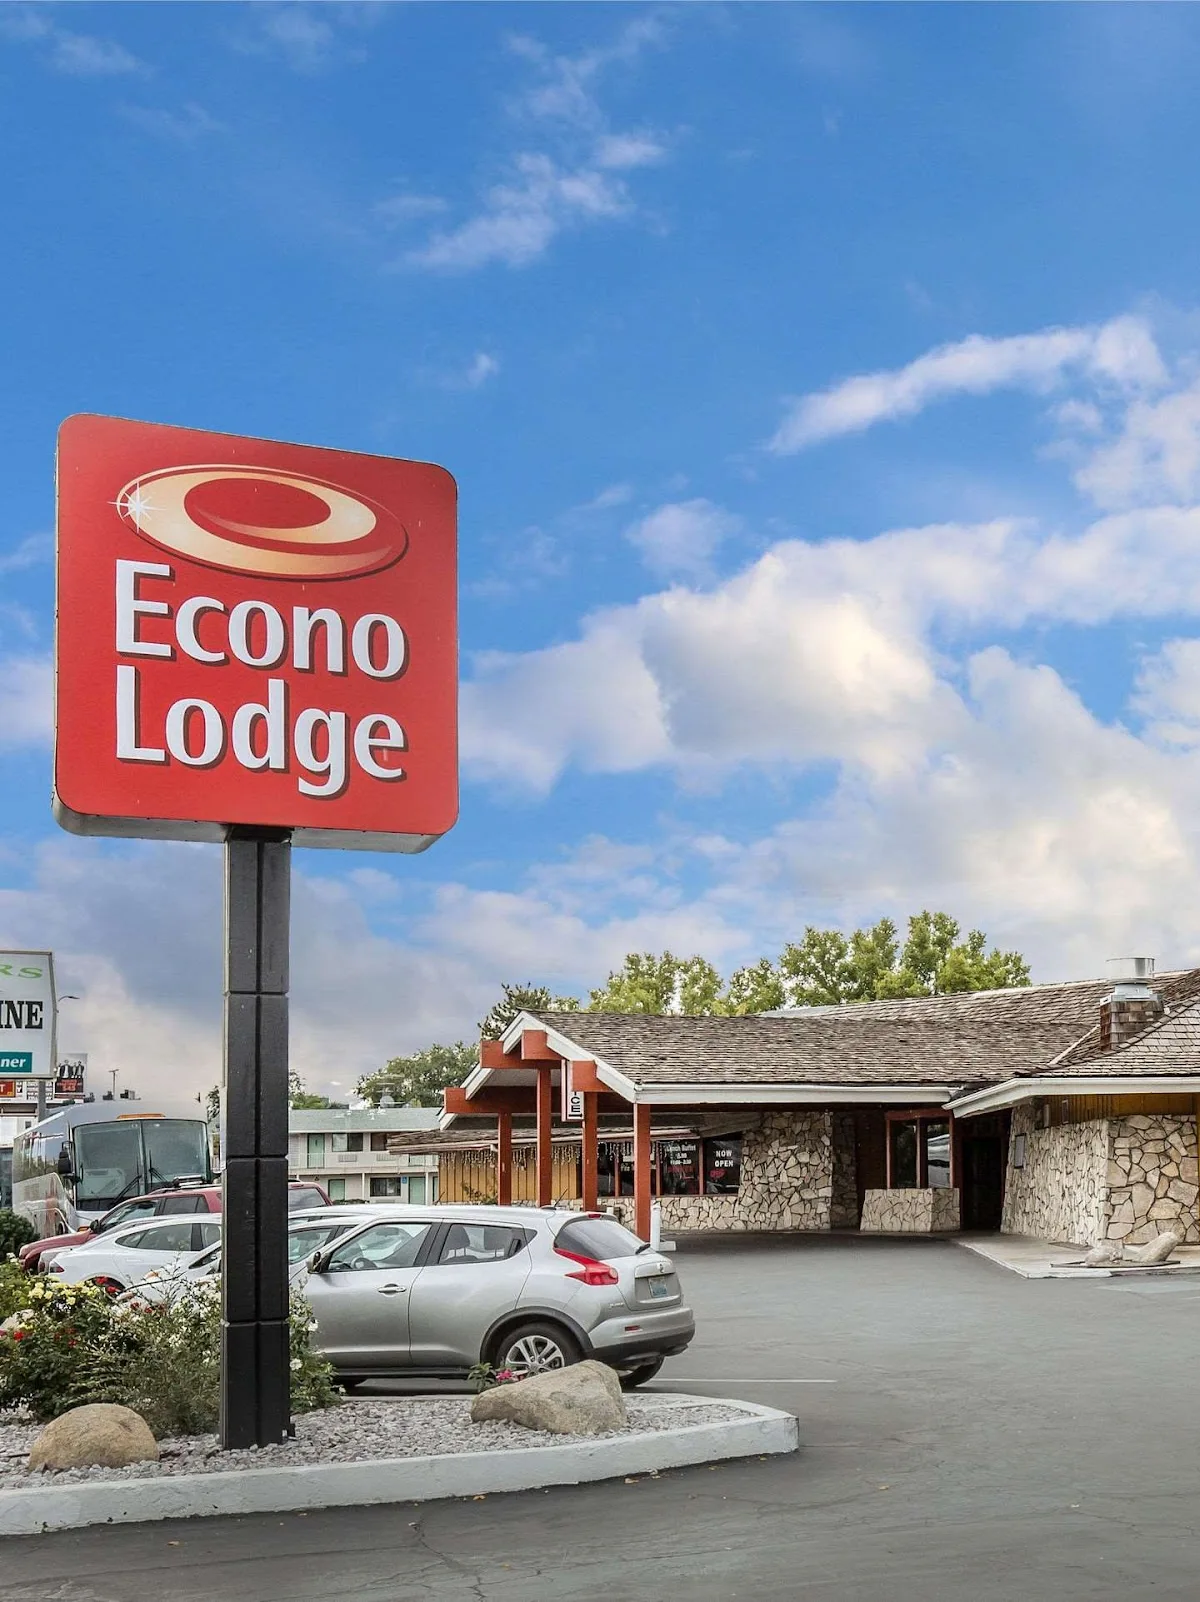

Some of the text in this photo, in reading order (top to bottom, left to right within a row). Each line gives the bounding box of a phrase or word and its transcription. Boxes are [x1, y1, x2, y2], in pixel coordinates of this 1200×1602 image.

[115, 558, 407, 679] Econo
[115, 665, 407, 798] Lodge
[0, 1000, 43, 1029] NE
[714, 1160, 734, 1168] OPEN
[715, 1150, 733, 1158] NOW
